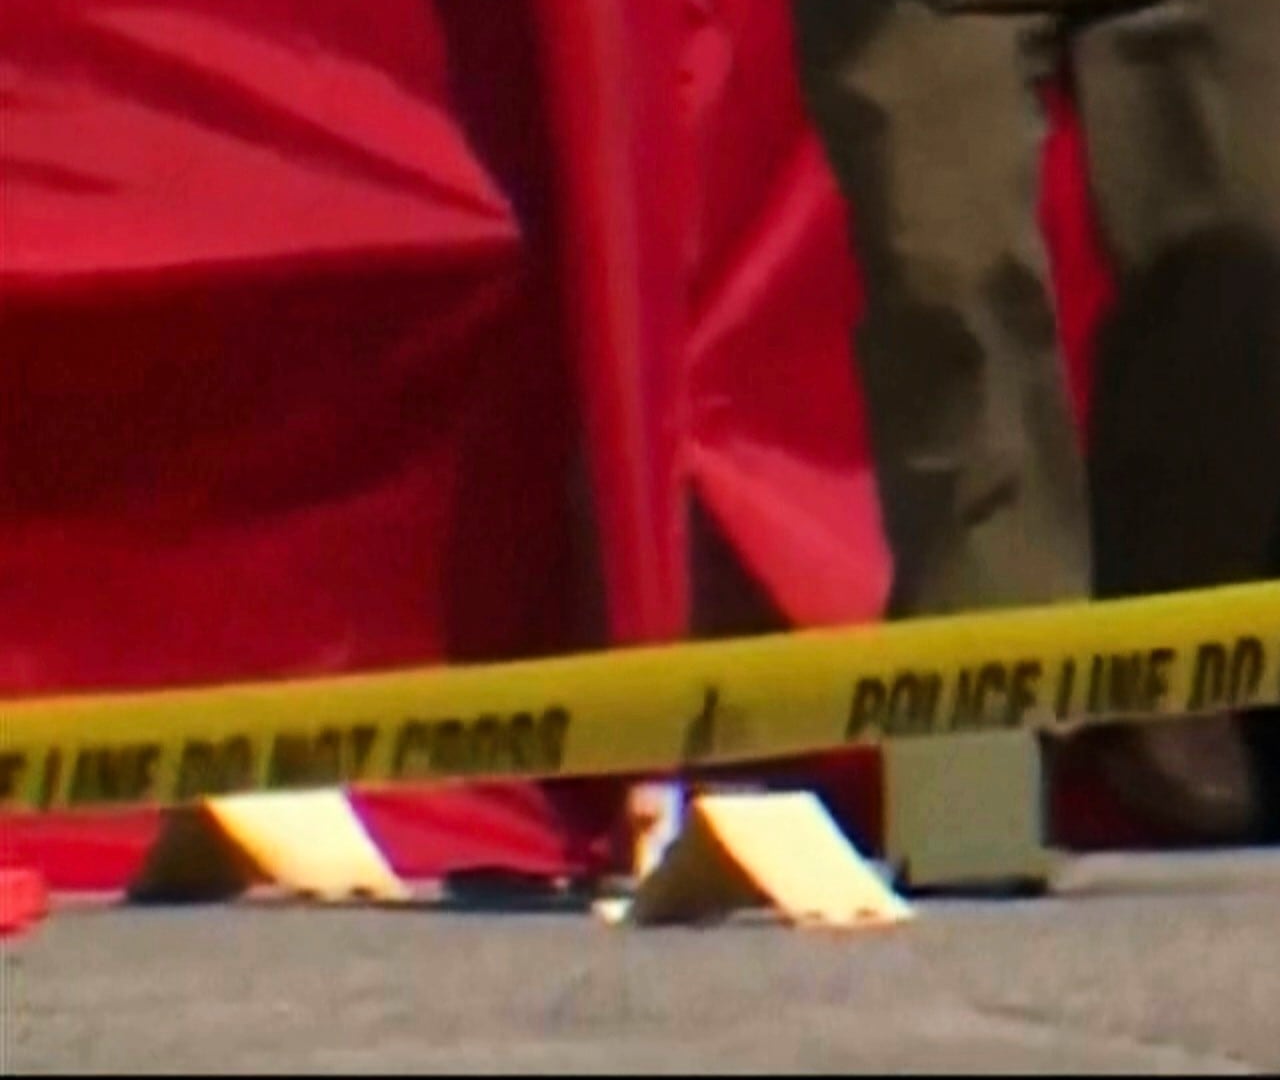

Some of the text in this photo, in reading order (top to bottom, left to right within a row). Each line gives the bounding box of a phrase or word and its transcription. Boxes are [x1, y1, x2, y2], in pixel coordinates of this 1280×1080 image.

[845, 660, 1042, 739] POLICE
[1055, 647, 1176, 723] LINE
[1187, 636, 1265, 710] DO
